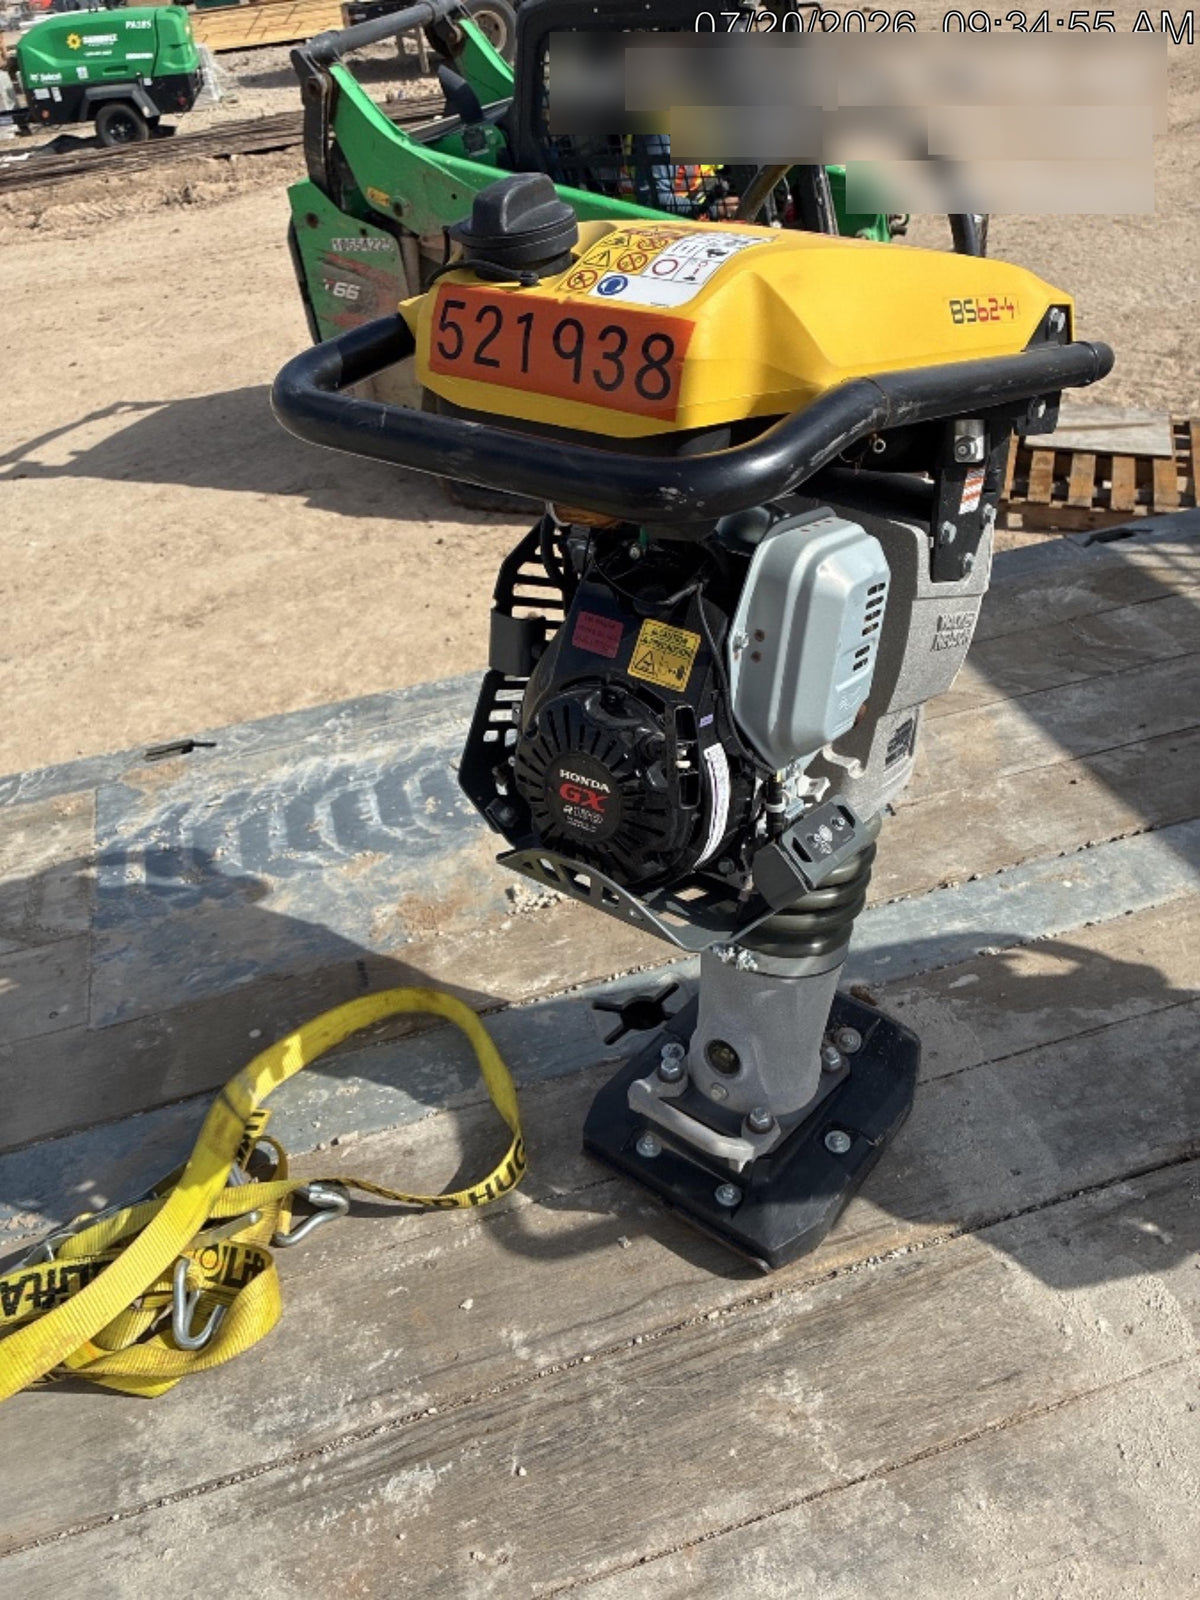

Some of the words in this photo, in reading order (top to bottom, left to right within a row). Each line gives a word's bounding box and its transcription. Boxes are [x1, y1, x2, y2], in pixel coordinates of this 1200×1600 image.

[949, 297, 1015, 324] BS62-4
[437, 299, 675, 401] 521938
[559, 768, 611, 794] HONDA
[559, 783, 609, 813] GX
